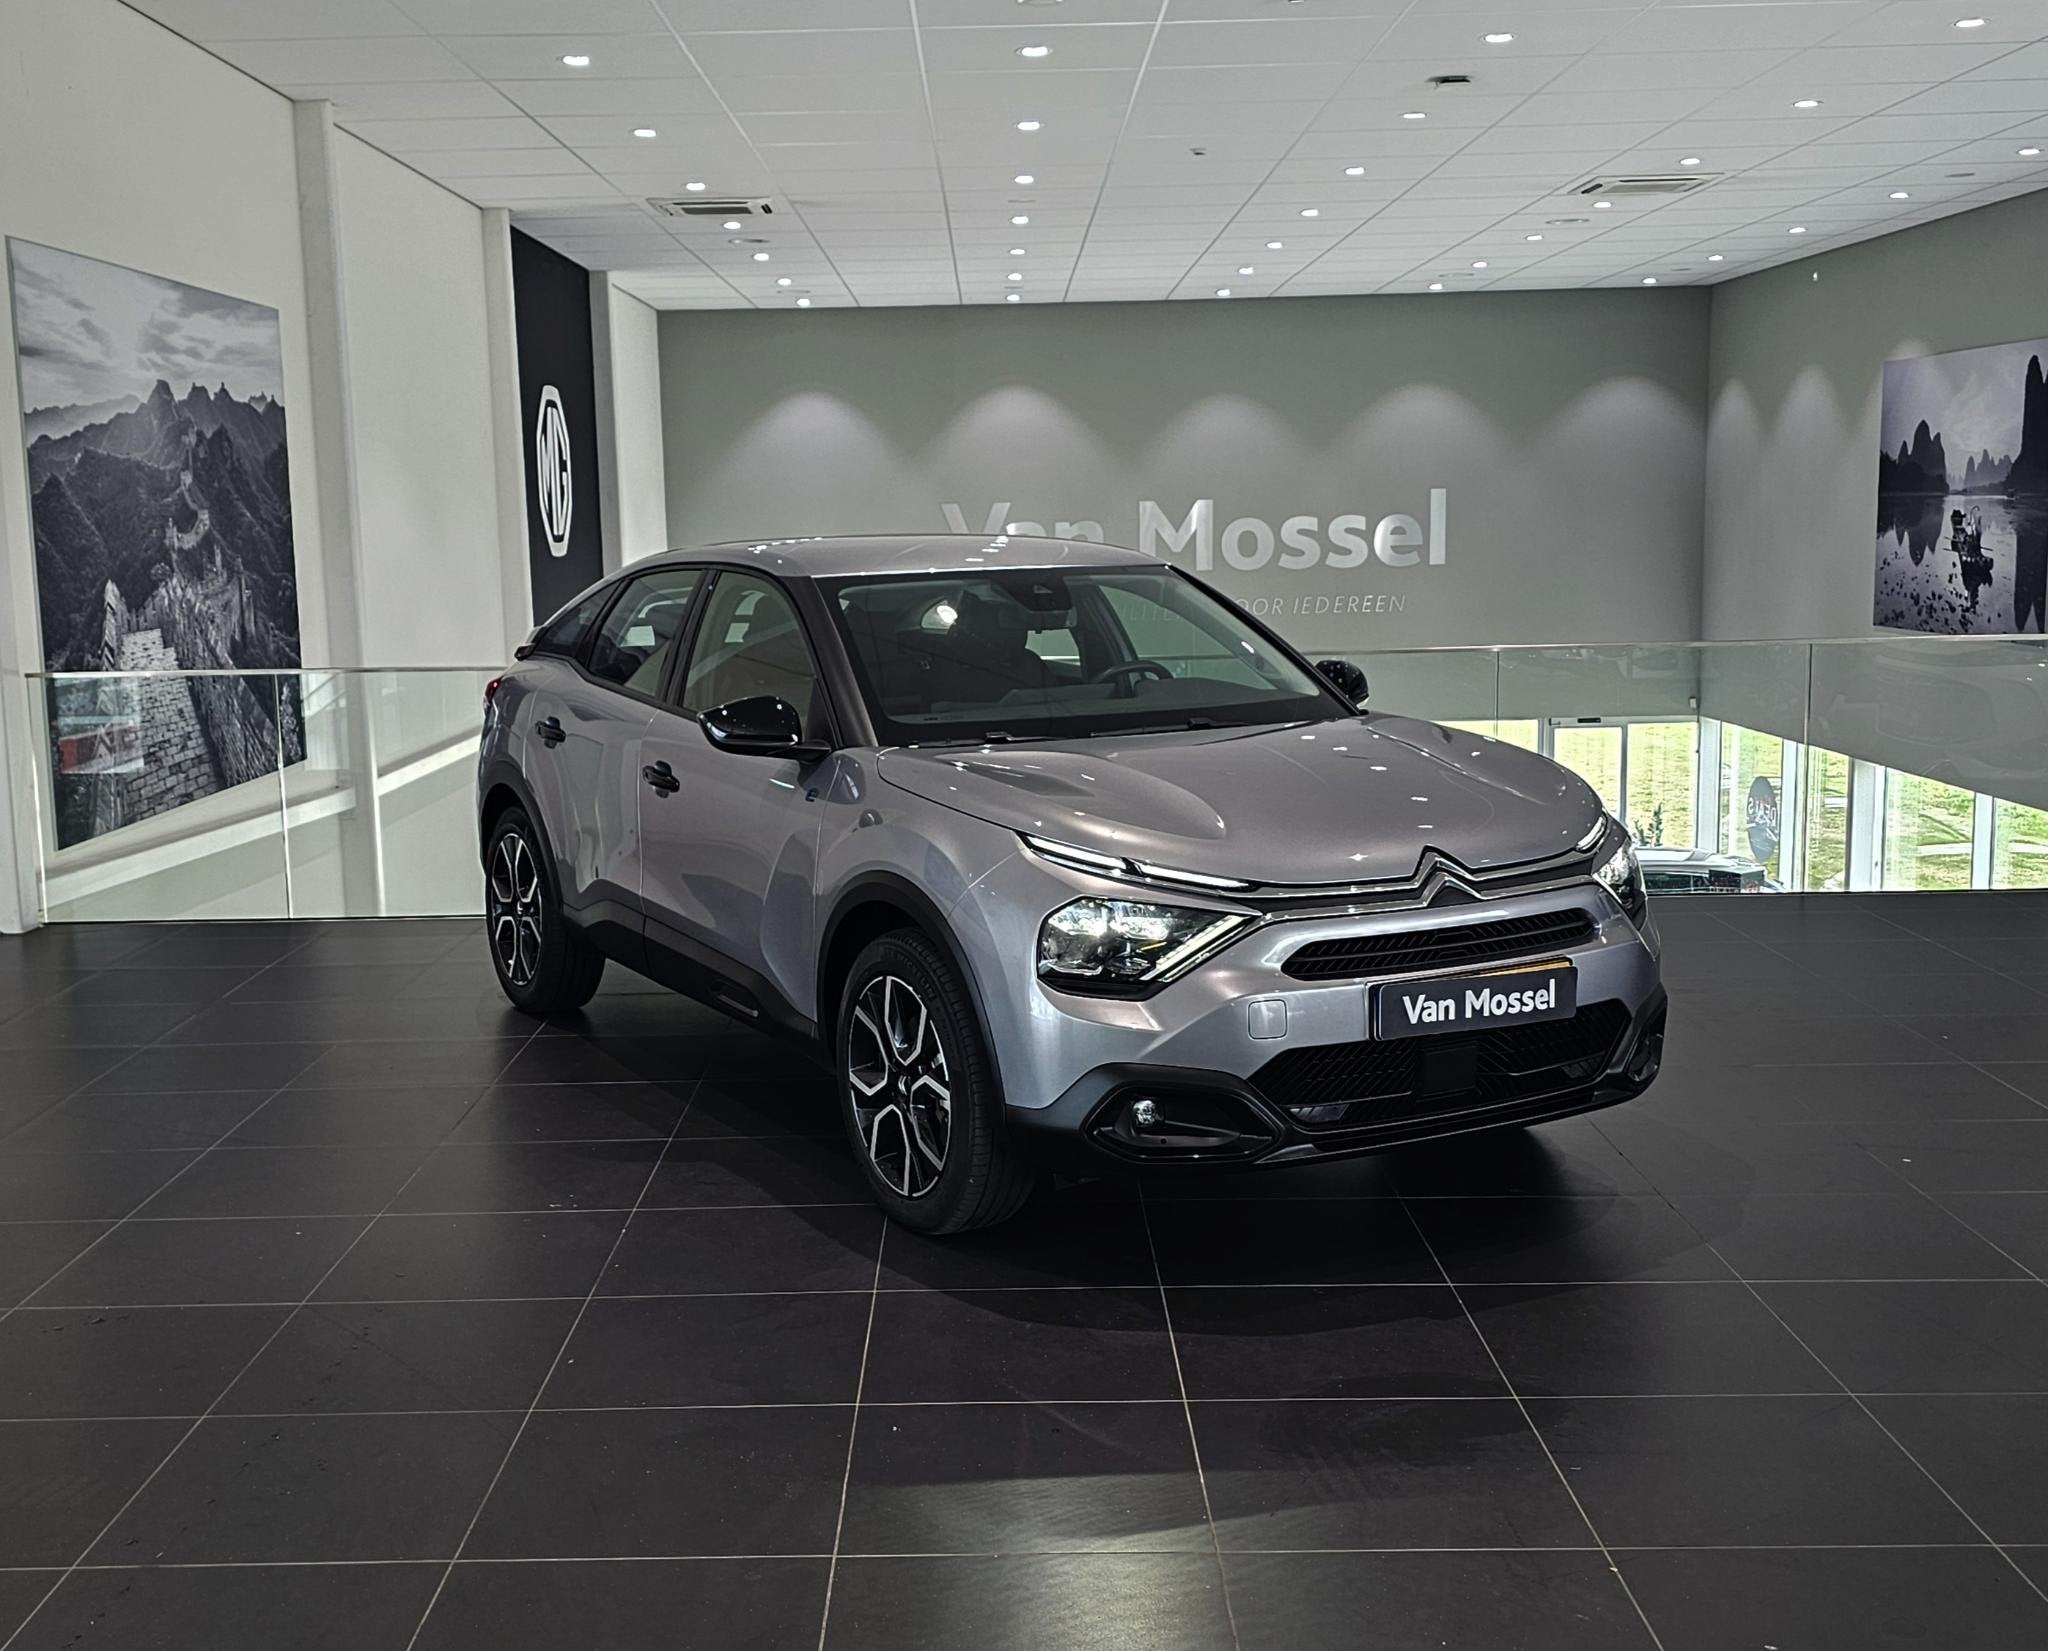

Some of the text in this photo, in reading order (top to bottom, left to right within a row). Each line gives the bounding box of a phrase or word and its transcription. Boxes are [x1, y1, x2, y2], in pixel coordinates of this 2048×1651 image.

[540, 405, 568, 537] MG
[1138, 488, 1447, 571] Mossel
[1235, 597, 1284, 616] OOR
[1292, 594, 1406, 615] IEDEREEN
[1402, 978, 1556, 1025] Van Mossel
